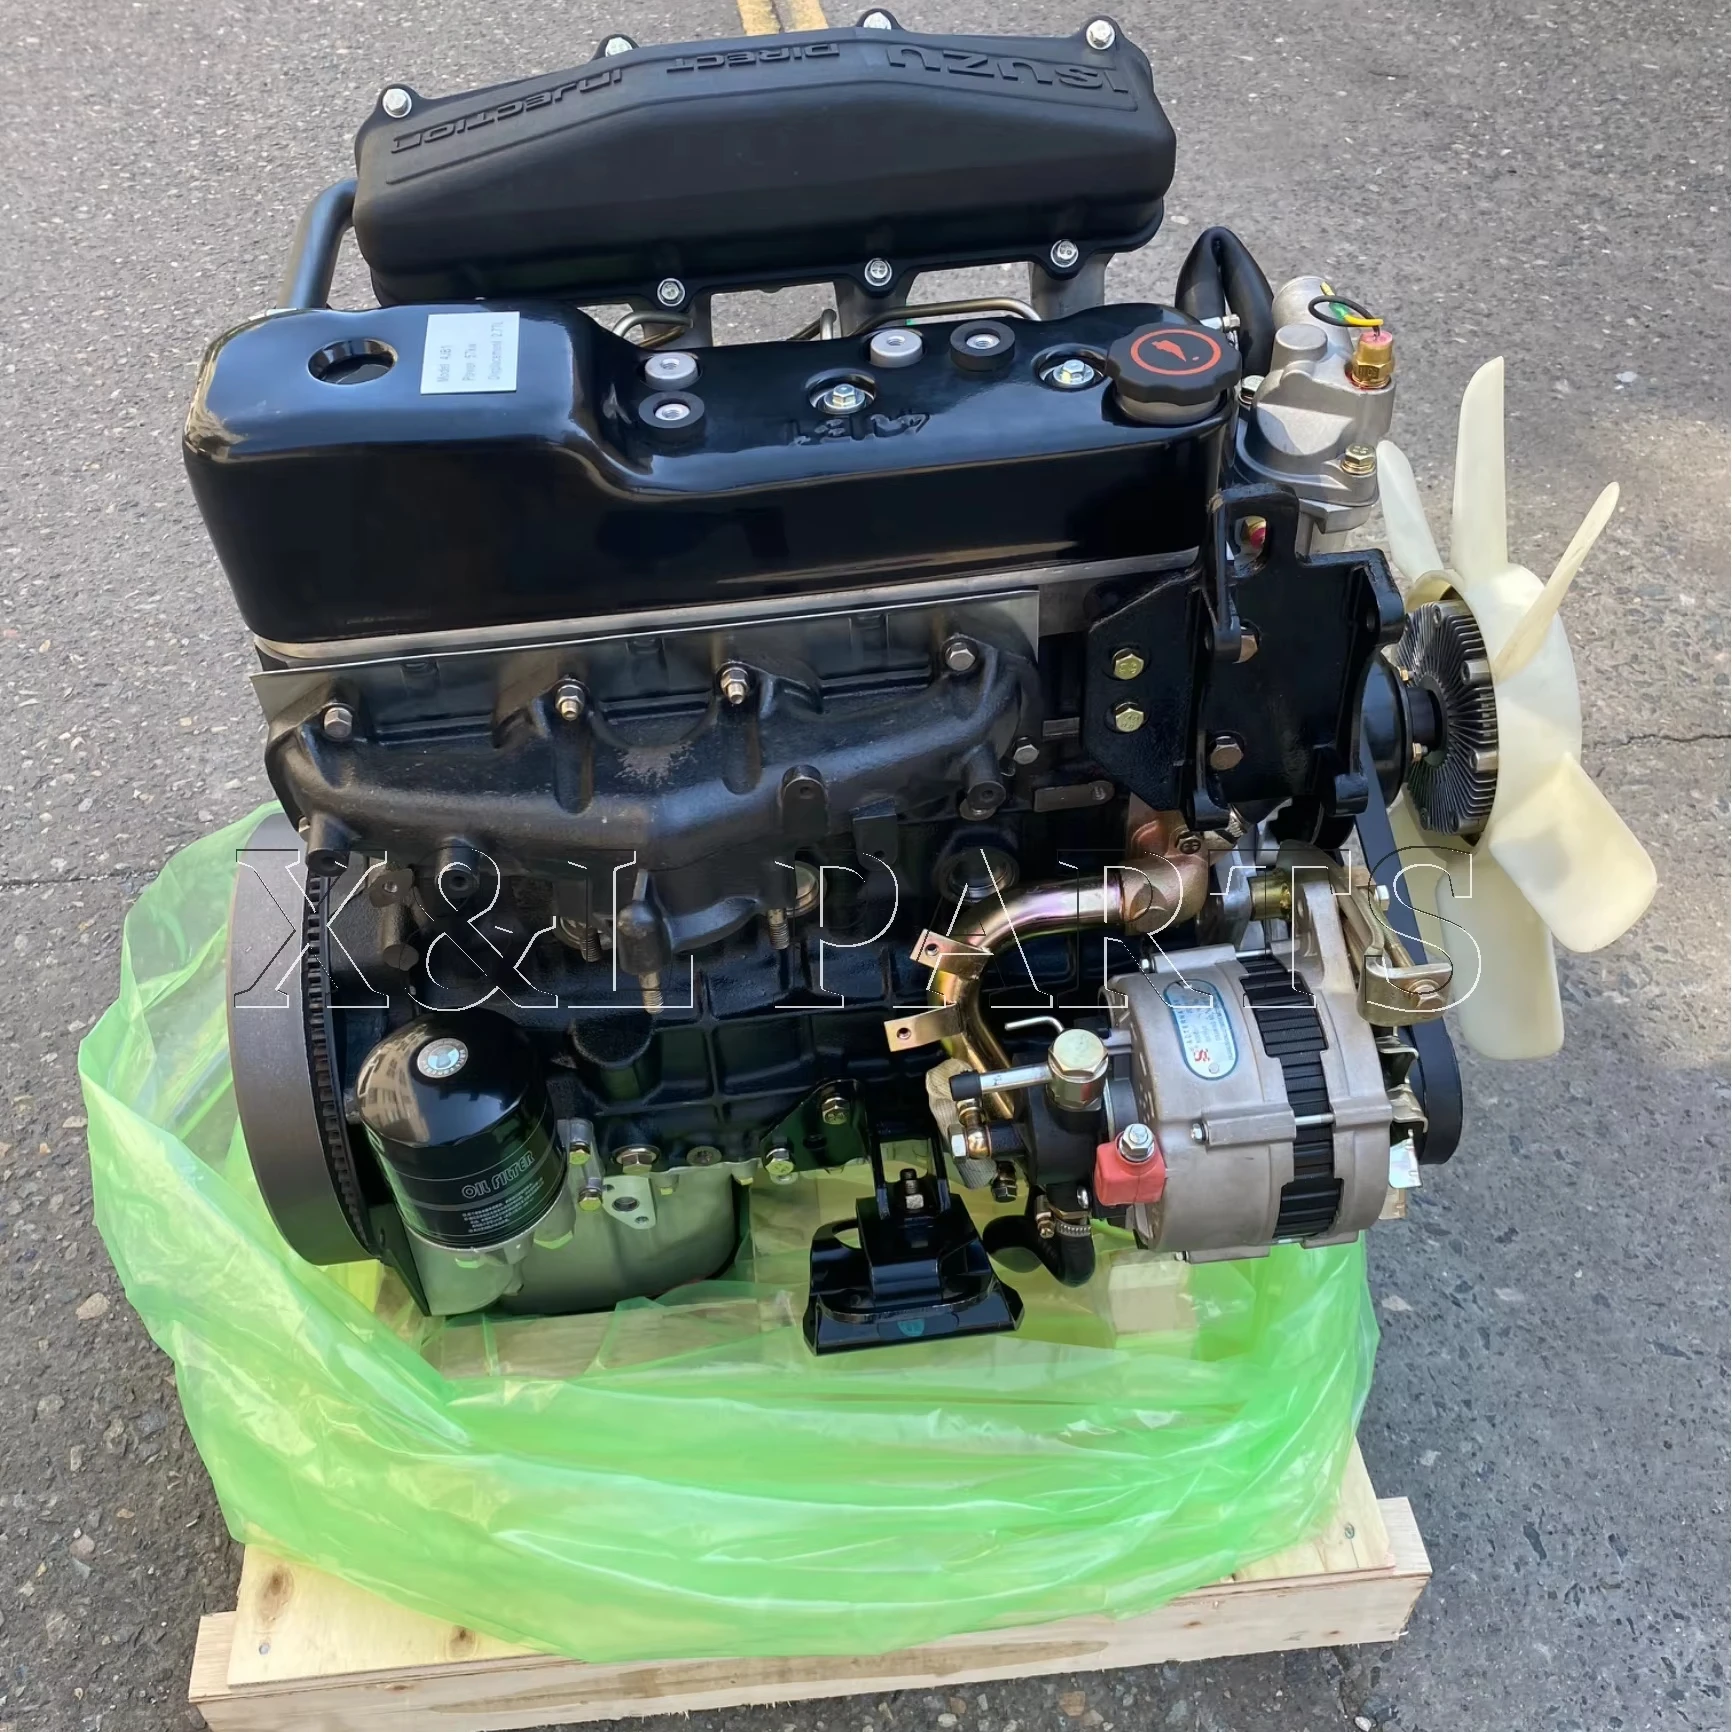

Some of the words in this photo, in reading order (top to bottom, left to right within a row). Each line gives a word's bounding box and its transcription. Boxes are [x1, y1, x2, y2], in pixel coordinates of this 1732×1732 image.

[666, 43, 841, 73] DIRECT
[885, 44, 1129, 94] ISUZU
[461, 1180, 492, 1199] OIL
[491, 1150, 536, 1190] FILTER
